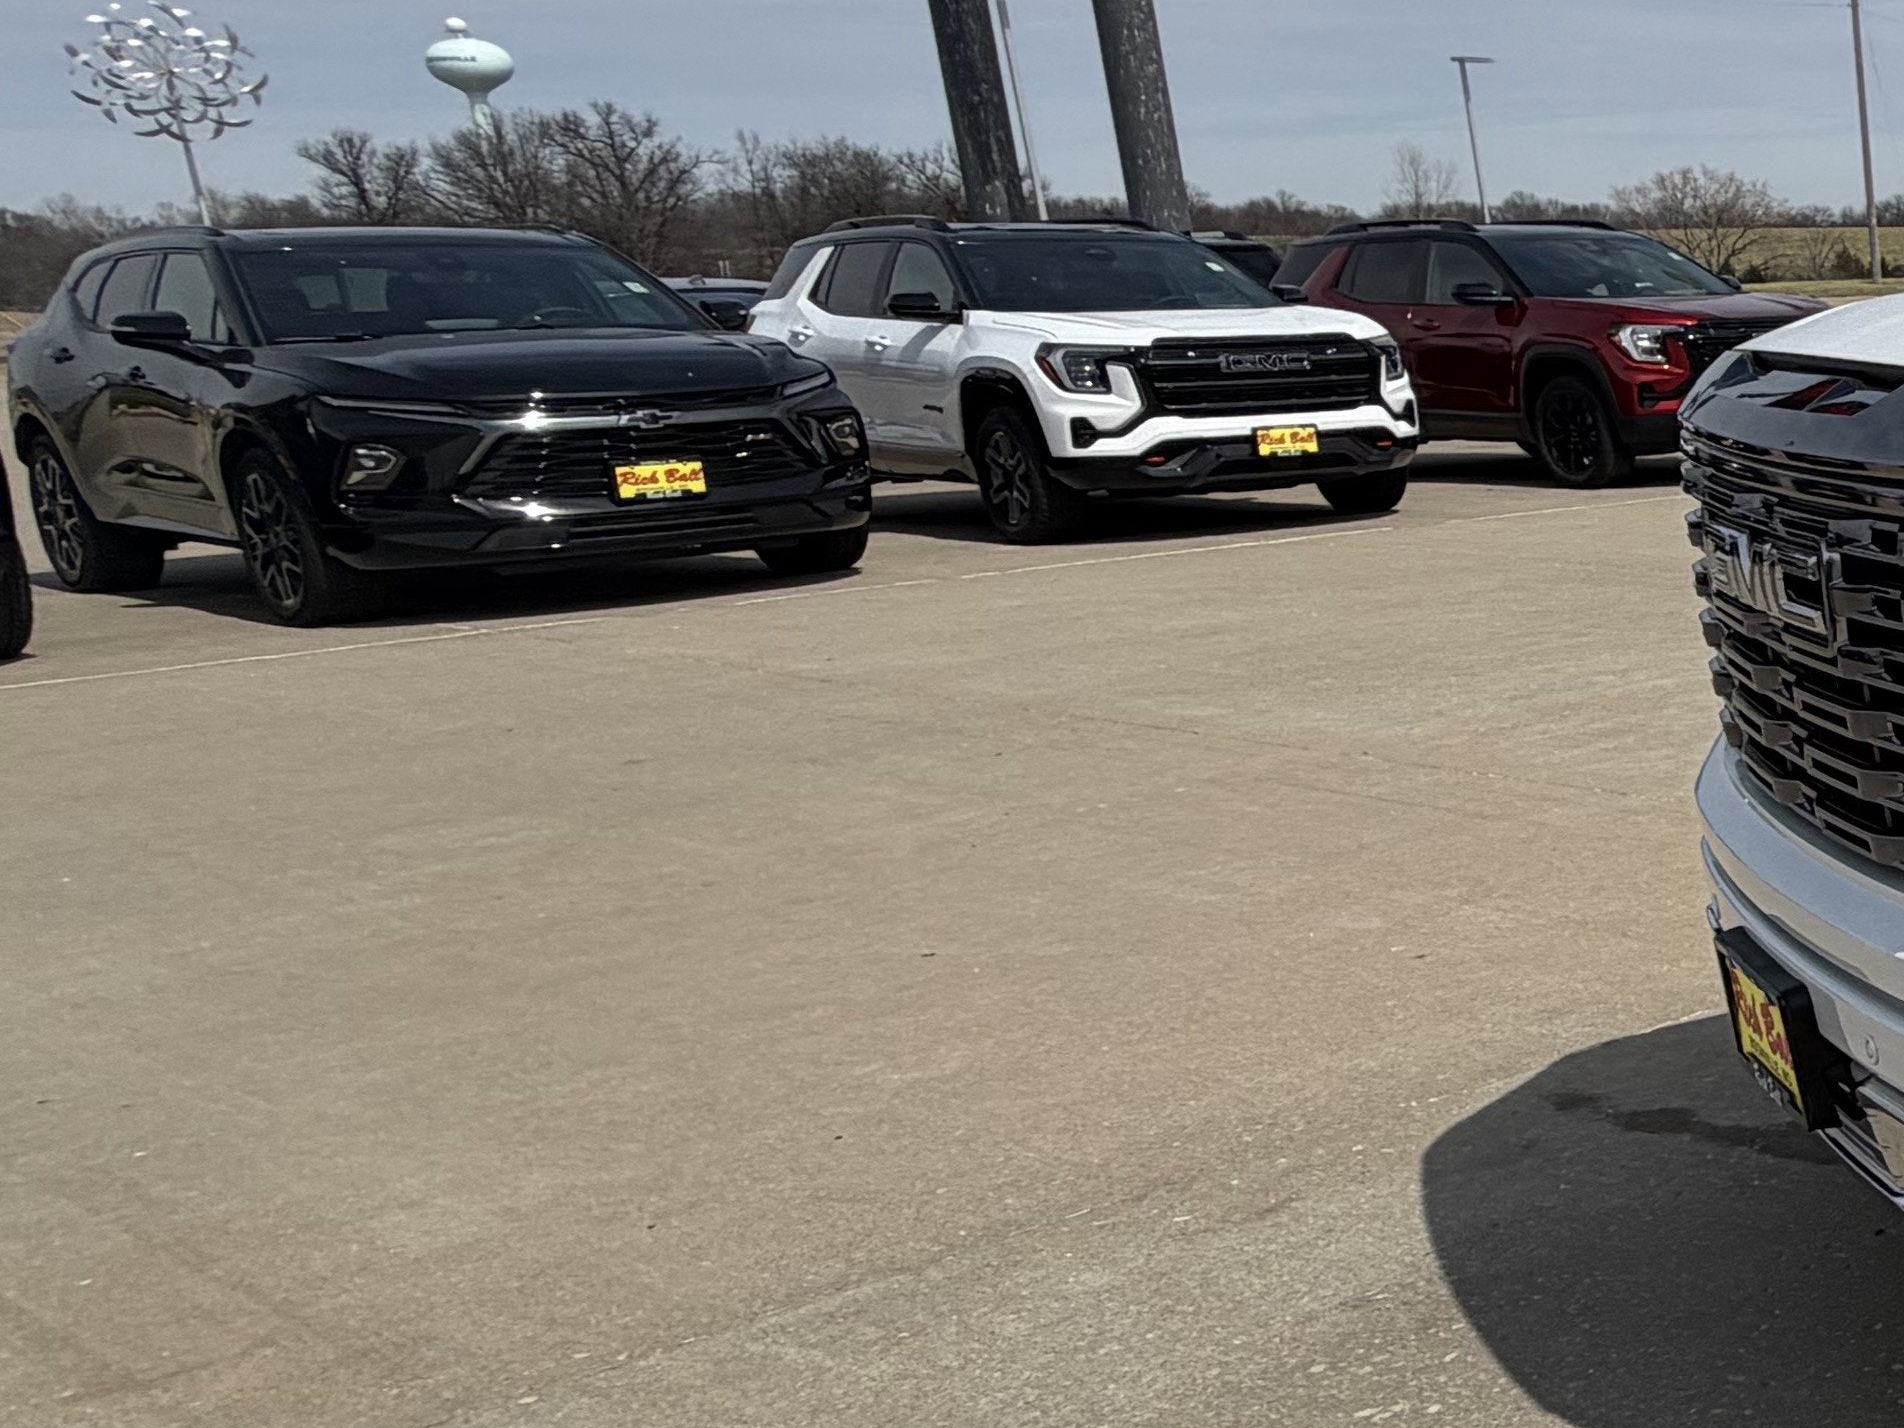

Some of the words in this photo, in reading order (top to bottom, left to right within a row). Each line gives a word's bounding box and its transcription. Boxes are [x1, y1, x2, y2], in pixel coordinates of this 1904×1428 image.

[1219, 352, 1310, 373] GMC
[619, 471, 660, 487] Rick
[664, 468, 703, 483] Ball
